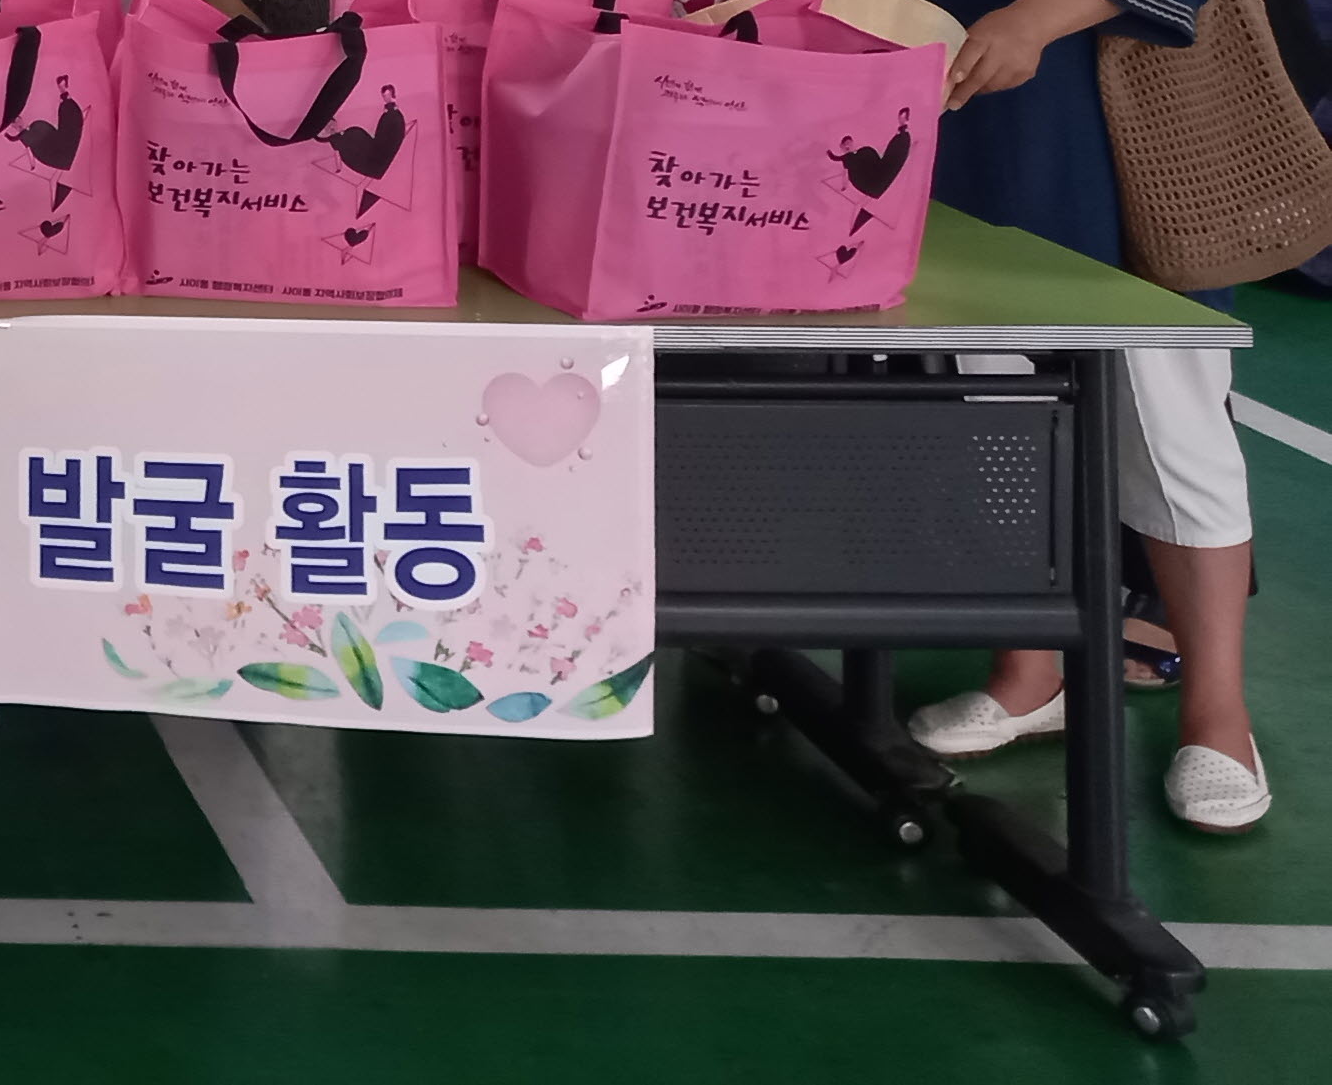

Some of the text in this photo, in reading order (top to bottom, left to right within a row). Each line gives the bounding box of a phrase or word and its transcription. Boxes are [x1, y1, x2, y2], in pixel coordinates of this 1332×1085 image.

[146, 140, 251, 186] 찾아가는
[647, 150, 761, 199] 찾아가는
[146, 180, 310, 219] 보건복지서비스
[644, 193, 811, 235] 보건복지서비스
[27, 454, 235, 591] 발굴
[275, 460, 486, 601] 활동
